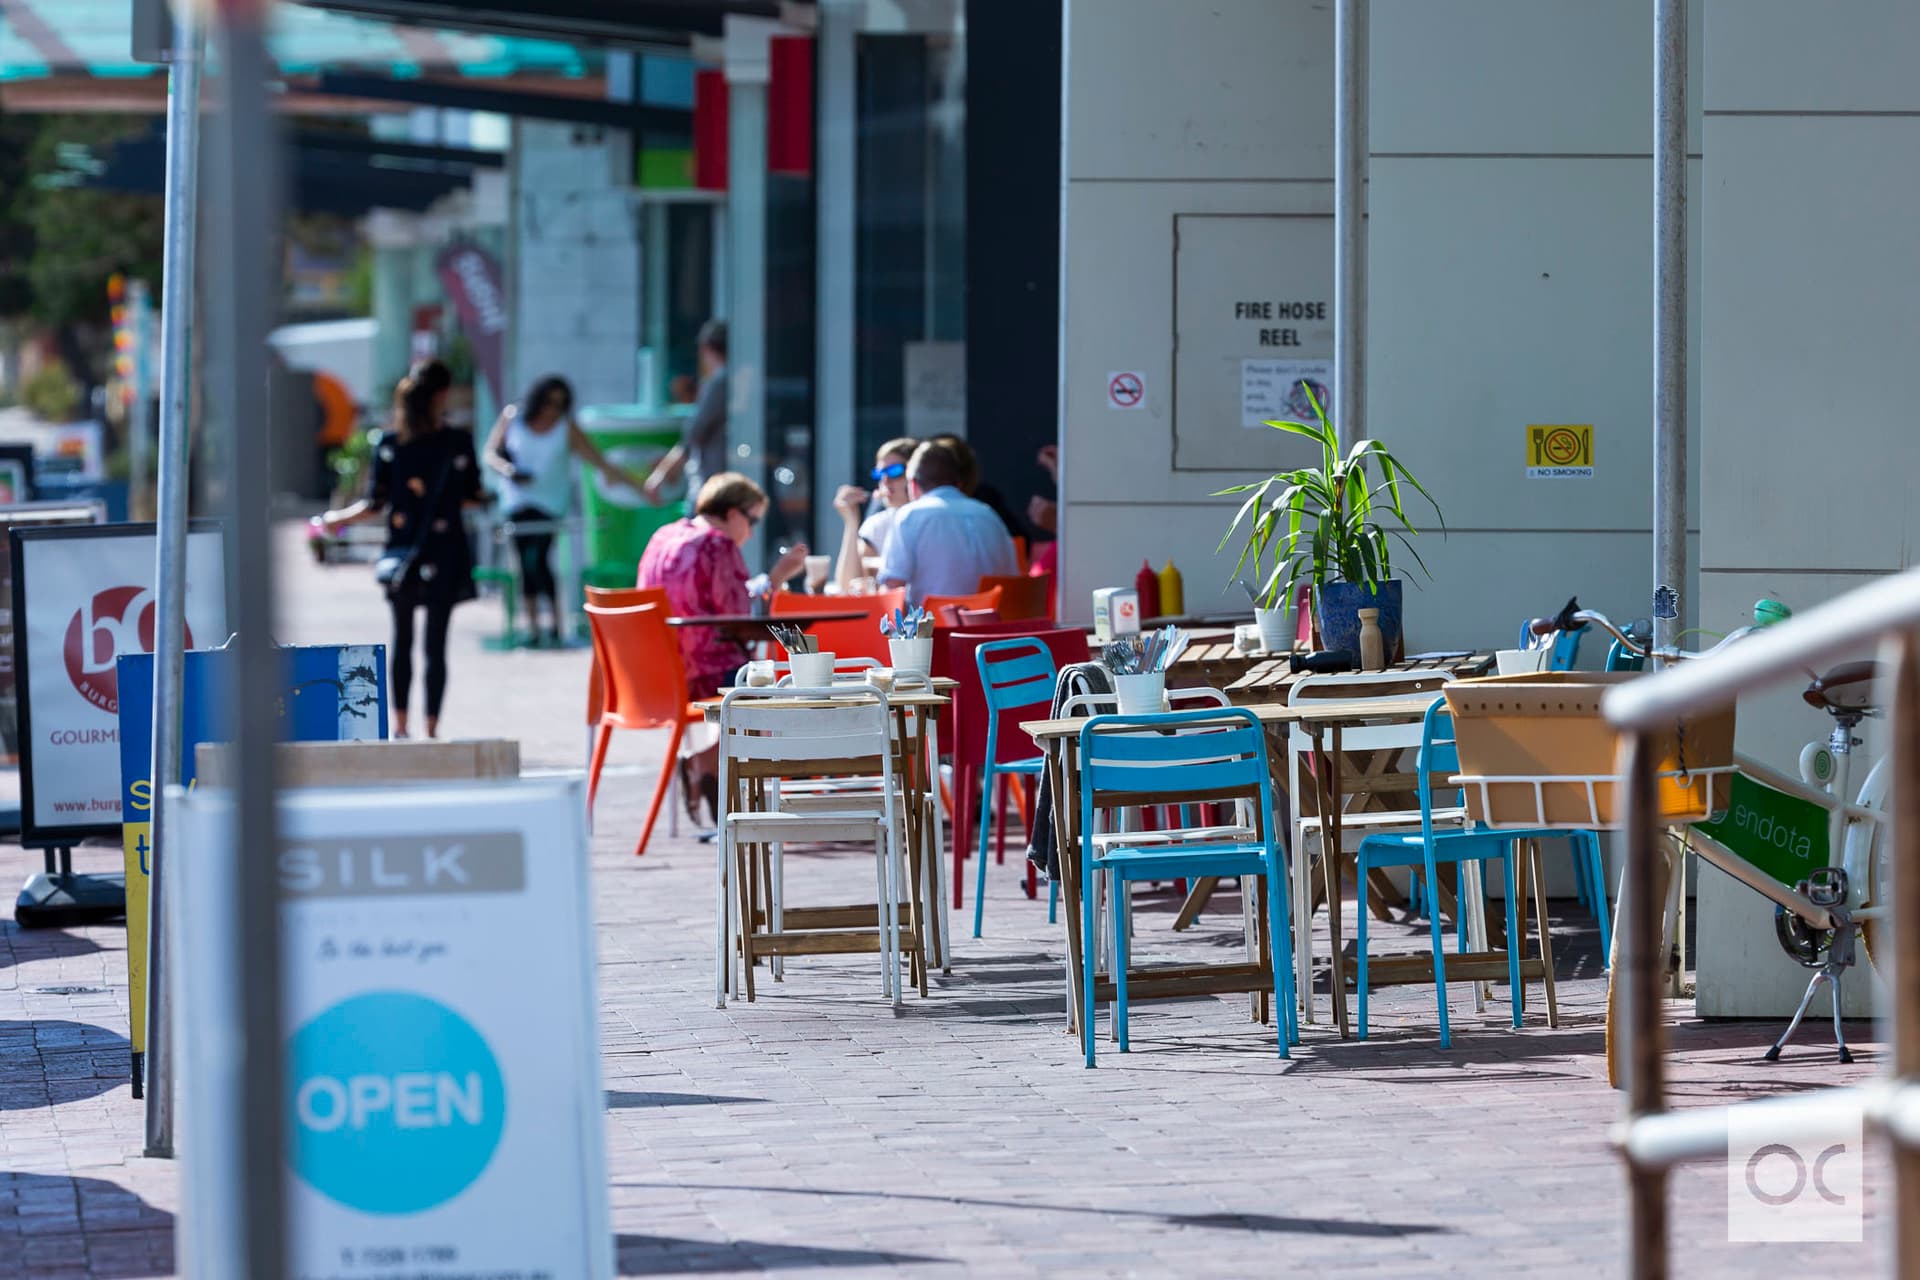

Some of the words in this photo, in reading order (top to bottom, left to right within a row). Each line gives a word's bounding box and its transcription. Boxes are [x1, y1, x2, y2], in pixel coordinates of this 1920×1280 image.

[1235, 301, 1272, 320] FIRE
[1278, 301, 1326, 320] HOSE
[1259, 328, 1301, 347] REEL
[1537, 467, 1551, 476] NO
[1553, 467, 1592, 476] SMOKING
[79, 680, 118, 712] BURG
[50, 728, 120, 746] GOURM
[53, 798, 122, 813] www.burg
[1735, 803, 1811, 860] endota
[277, 844, 470, 892] SILK
[297, 1070, 485, 1133] OPEN
